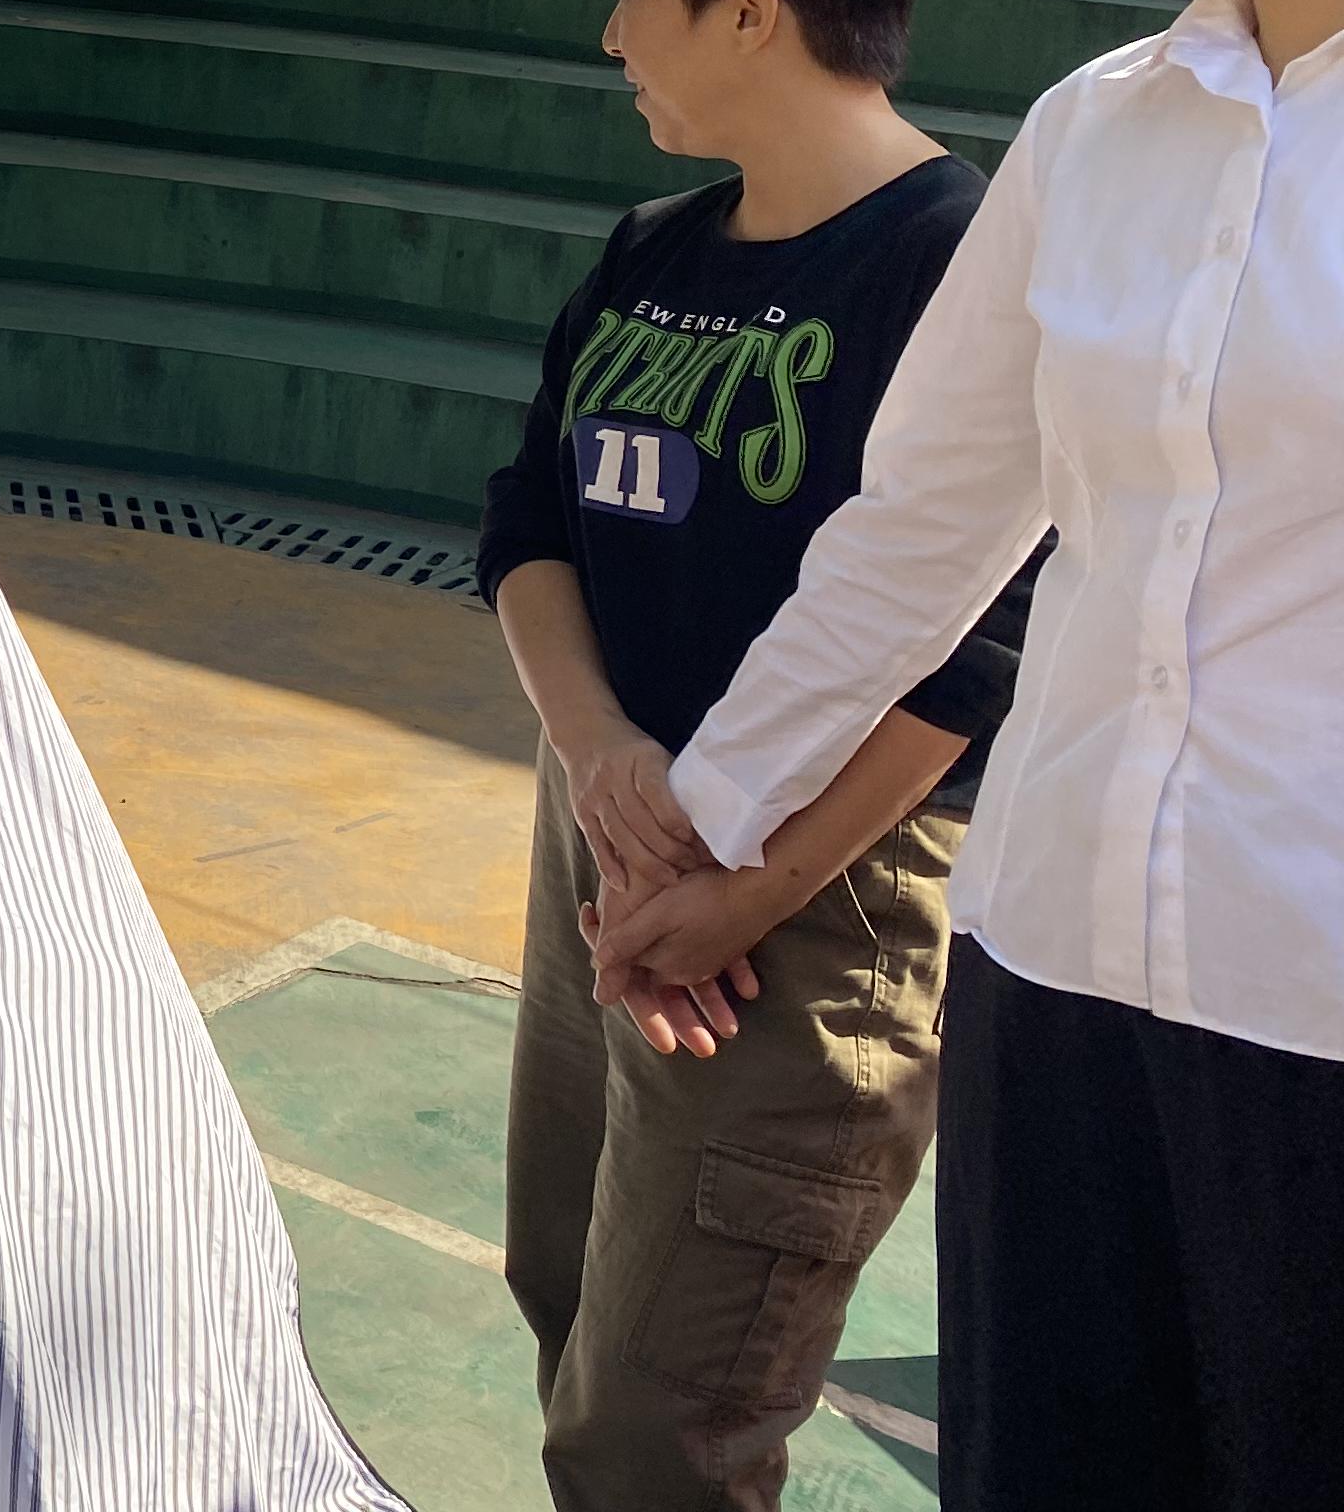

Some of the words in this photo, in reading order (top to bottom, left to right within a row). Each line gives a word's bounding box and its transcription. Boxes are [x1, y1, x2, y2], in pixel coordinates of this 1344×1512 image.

[633, 300, 675, 326] EW
[680, 305, 787, 333] ENGLD
[584, 427, 667, 514] 11
